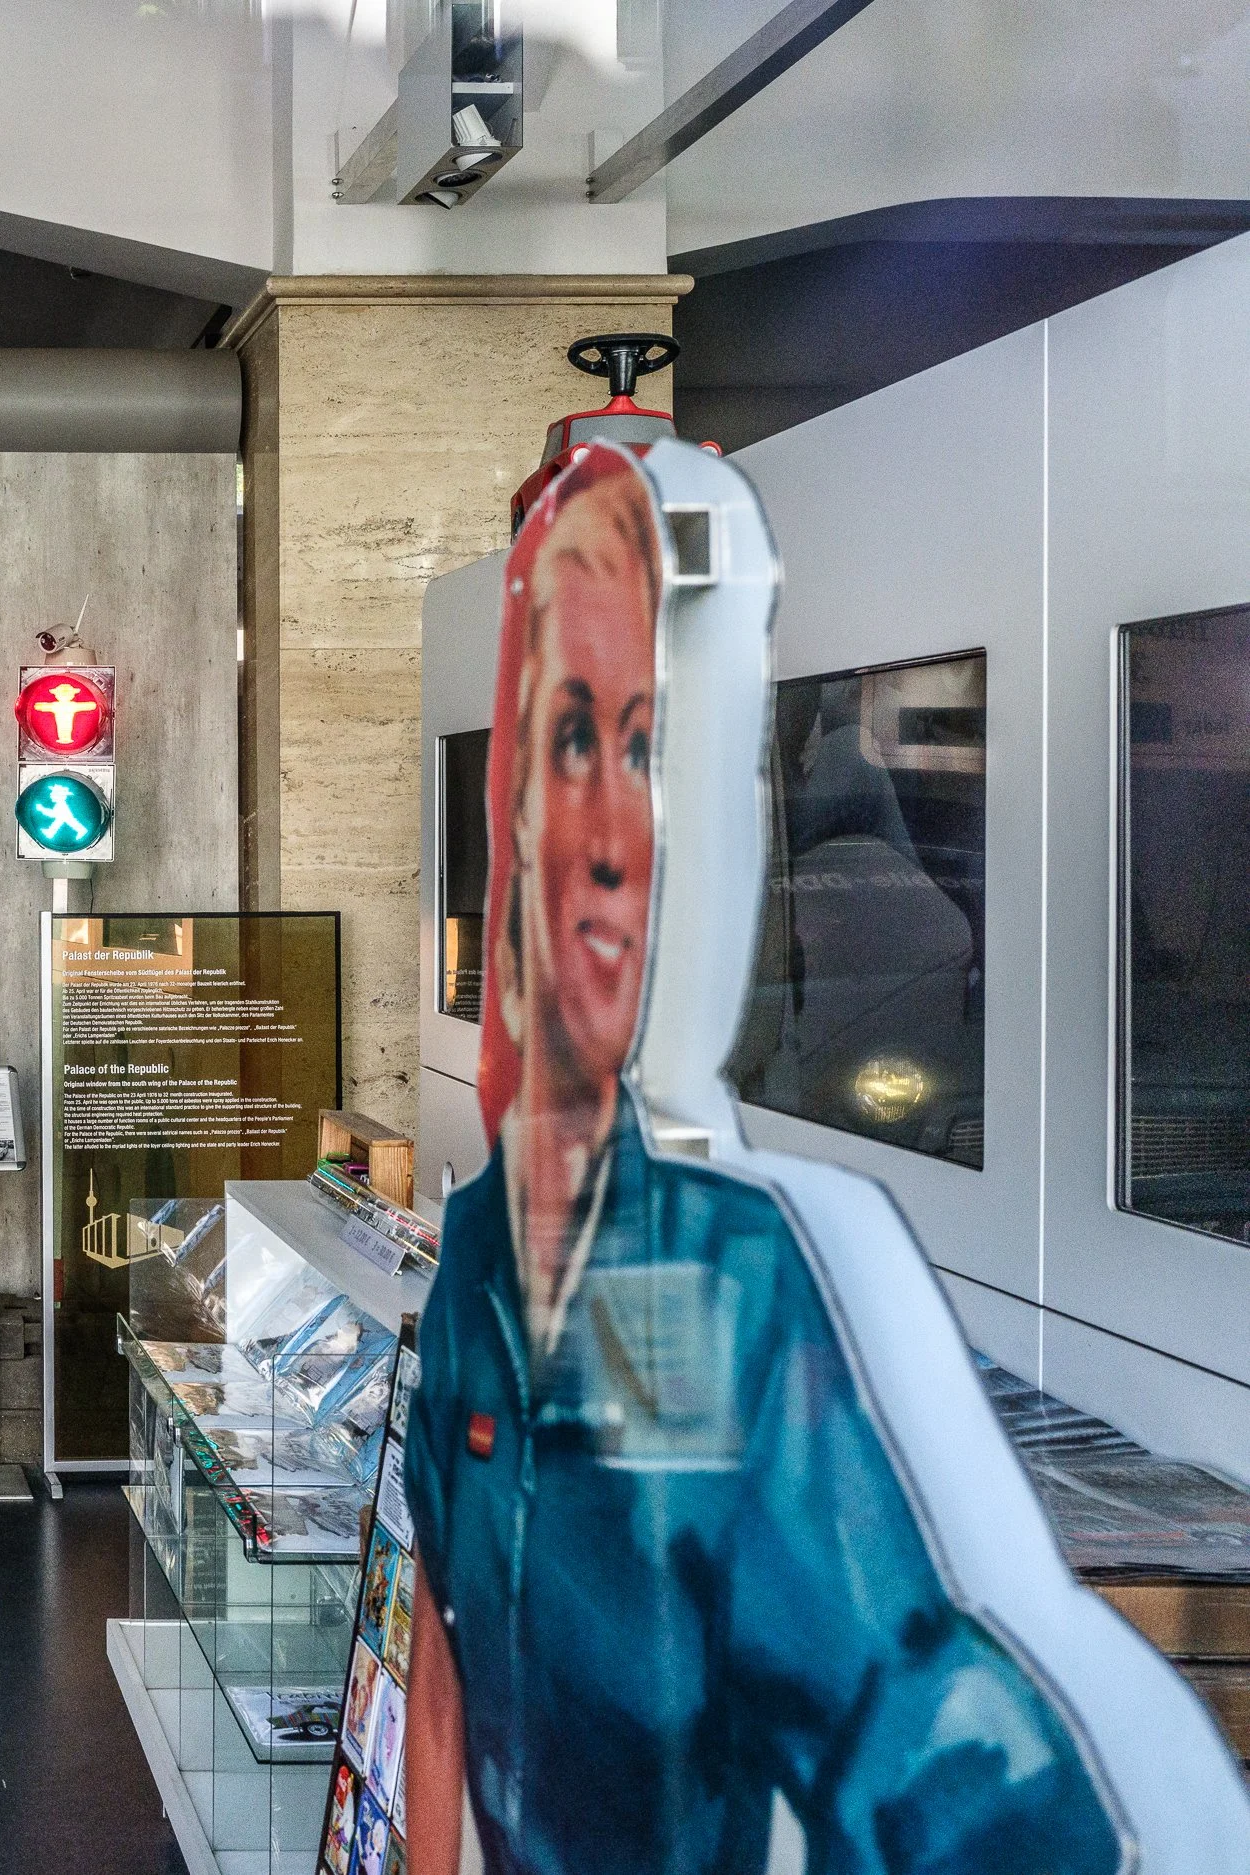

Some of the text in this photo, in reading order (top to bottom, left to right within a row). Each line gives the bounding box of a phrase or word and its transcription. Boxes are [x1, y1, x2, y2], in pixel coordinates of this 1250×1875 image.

[62, 950, 154, 961] Palast der Republik
[64, 1064, 169, 1075] Palace of the Republic
[64, 1080, 85, 1088] Original
[148, 1079, 161, 1088] wing
[214, 1078, 237, 1087] Republic
